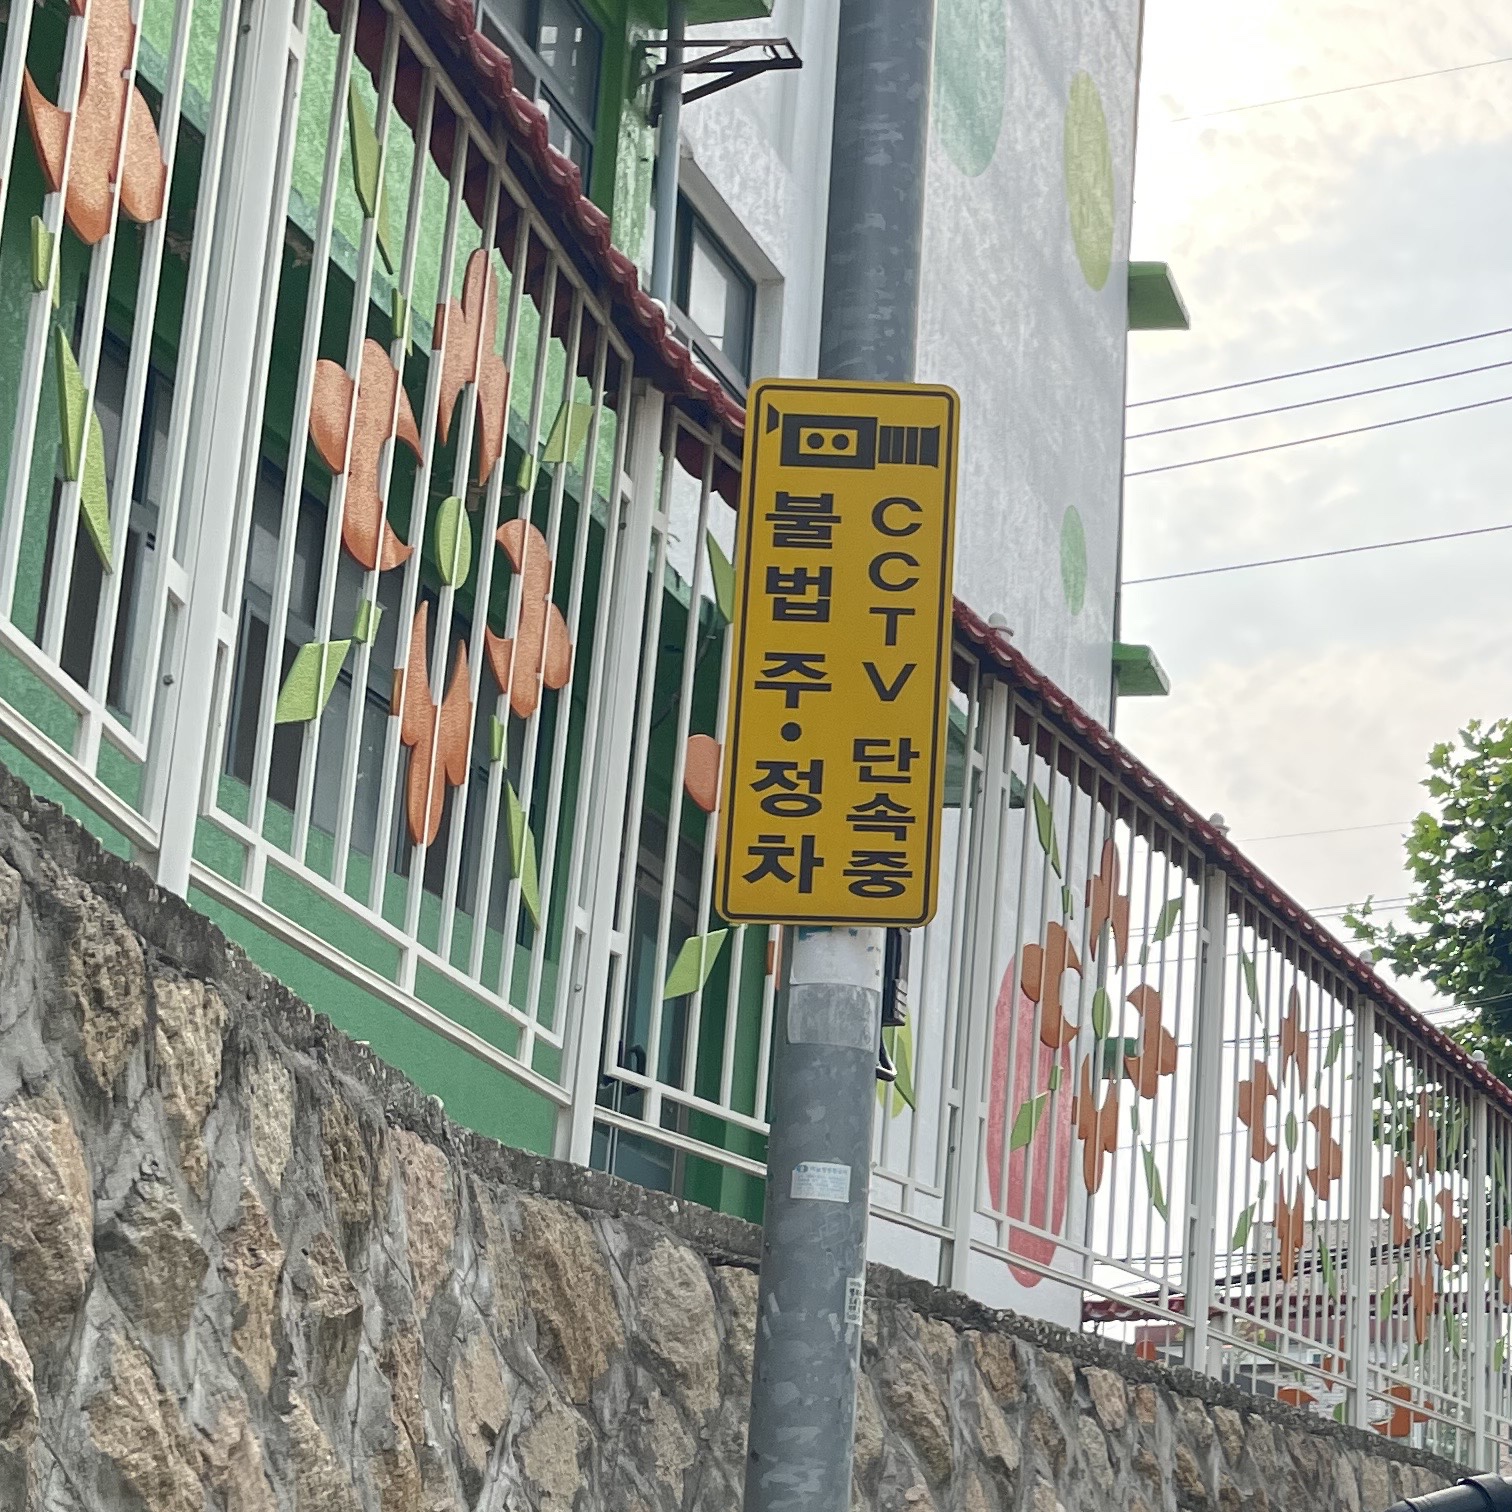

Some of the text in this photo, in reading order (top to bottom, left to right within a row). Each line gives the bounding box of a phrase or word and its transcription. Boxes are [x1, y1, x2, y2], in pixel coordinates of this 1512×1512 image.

[765, 490, 842, 623] 불법
[843, 496, 923, 898] CCTV 단속중
